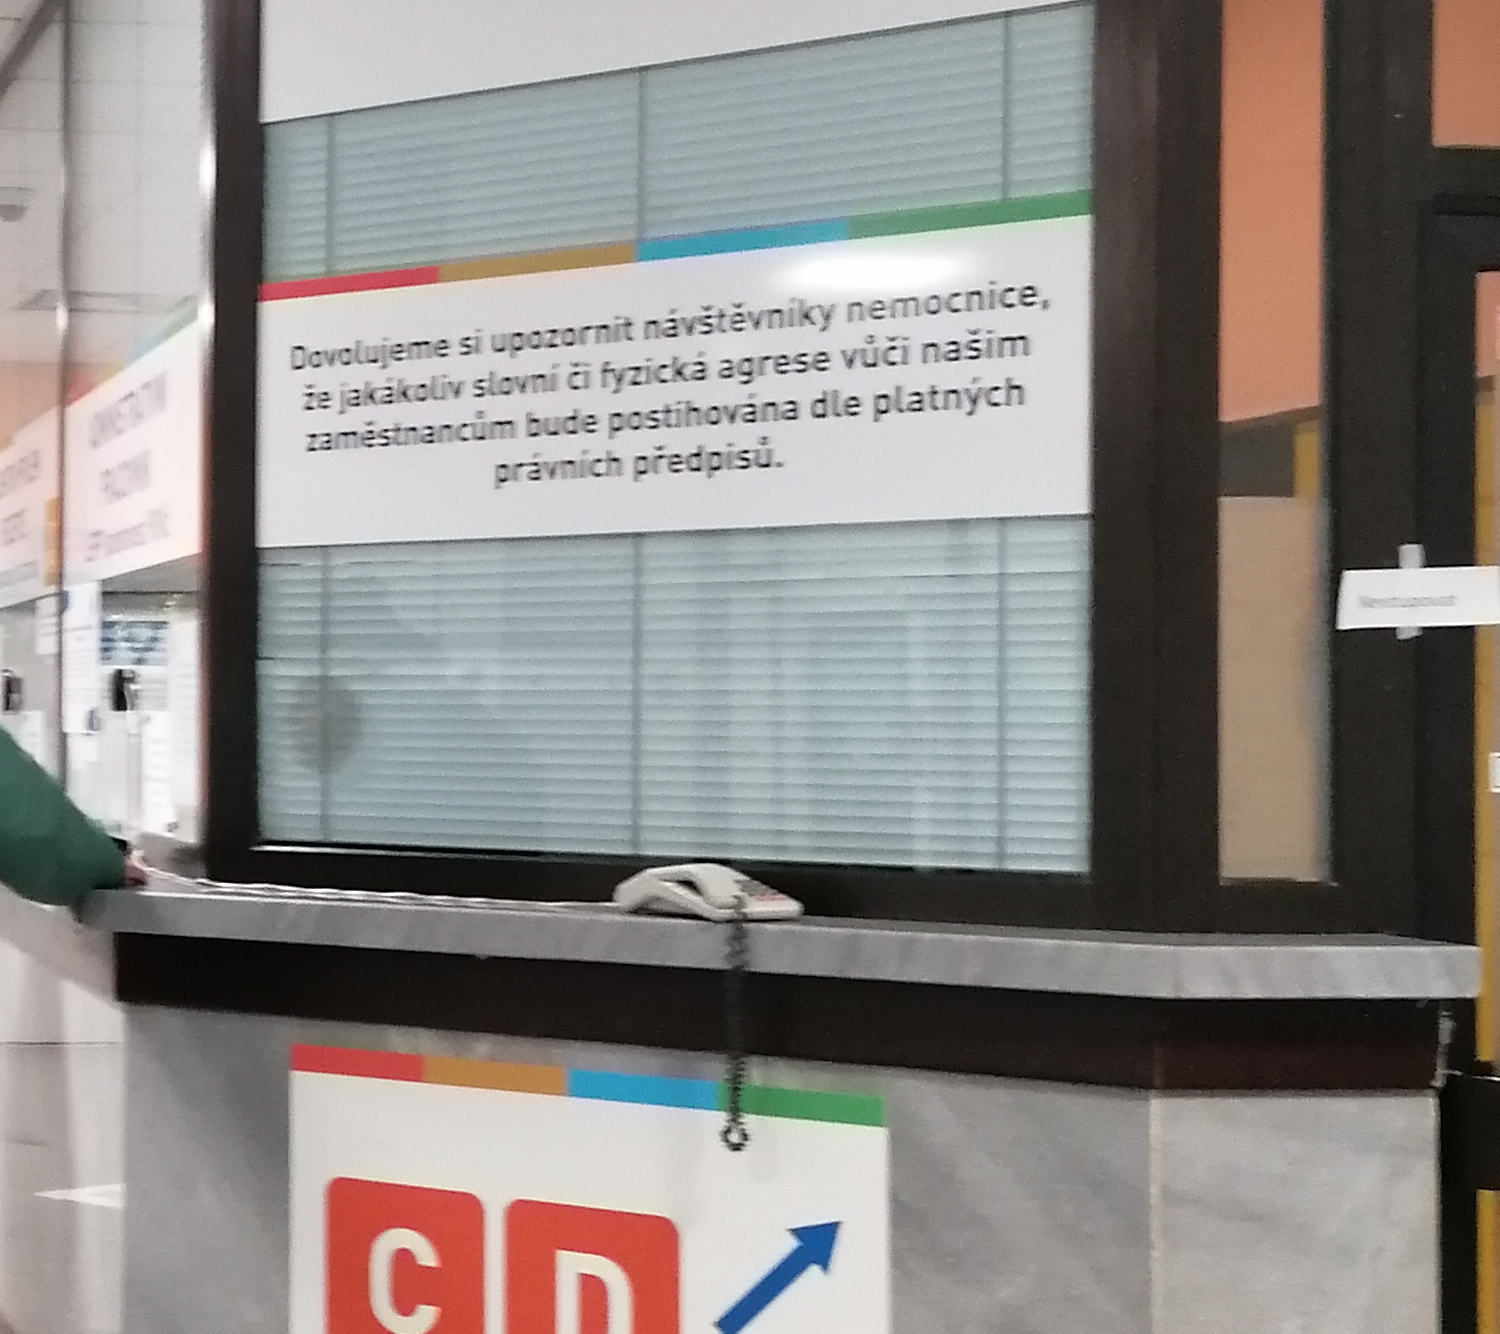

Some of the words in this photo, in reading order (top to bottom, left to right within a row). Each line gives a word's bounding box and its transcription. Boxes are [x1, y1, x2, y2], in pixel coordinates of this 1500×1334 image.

[290, 336, 450, 370] Dovolujeme
[458, 328, 483, 355] si
[490, 316, 633, 358] upozornit
[643, 297, 837, 339] návštěvníky
[847, 280, 1050, 322] nemocnice,
[302, 383, 332, 410] že
[337, 374, 467, 414] jakákoliv
[472, 362, 560, 398] slovní
[567, 361, 591, 390] či
[601, 351, 707, 394] fyzická
[718, 351, 832, 385] agrese
[840, 334, 910, 369] vůči
[921, 328, 1031, 364] našim
[305, 410, 519, 452] zaměstnancům
[525, 409, 599, 437] bude
[608, 393, 799, 439] postihována
[810, 389, 862, 419] dle
[873, 377, 1026, 422] platných
[494, 449, 624, 489] právních
[632, 436, 784, 482] předpisů.
